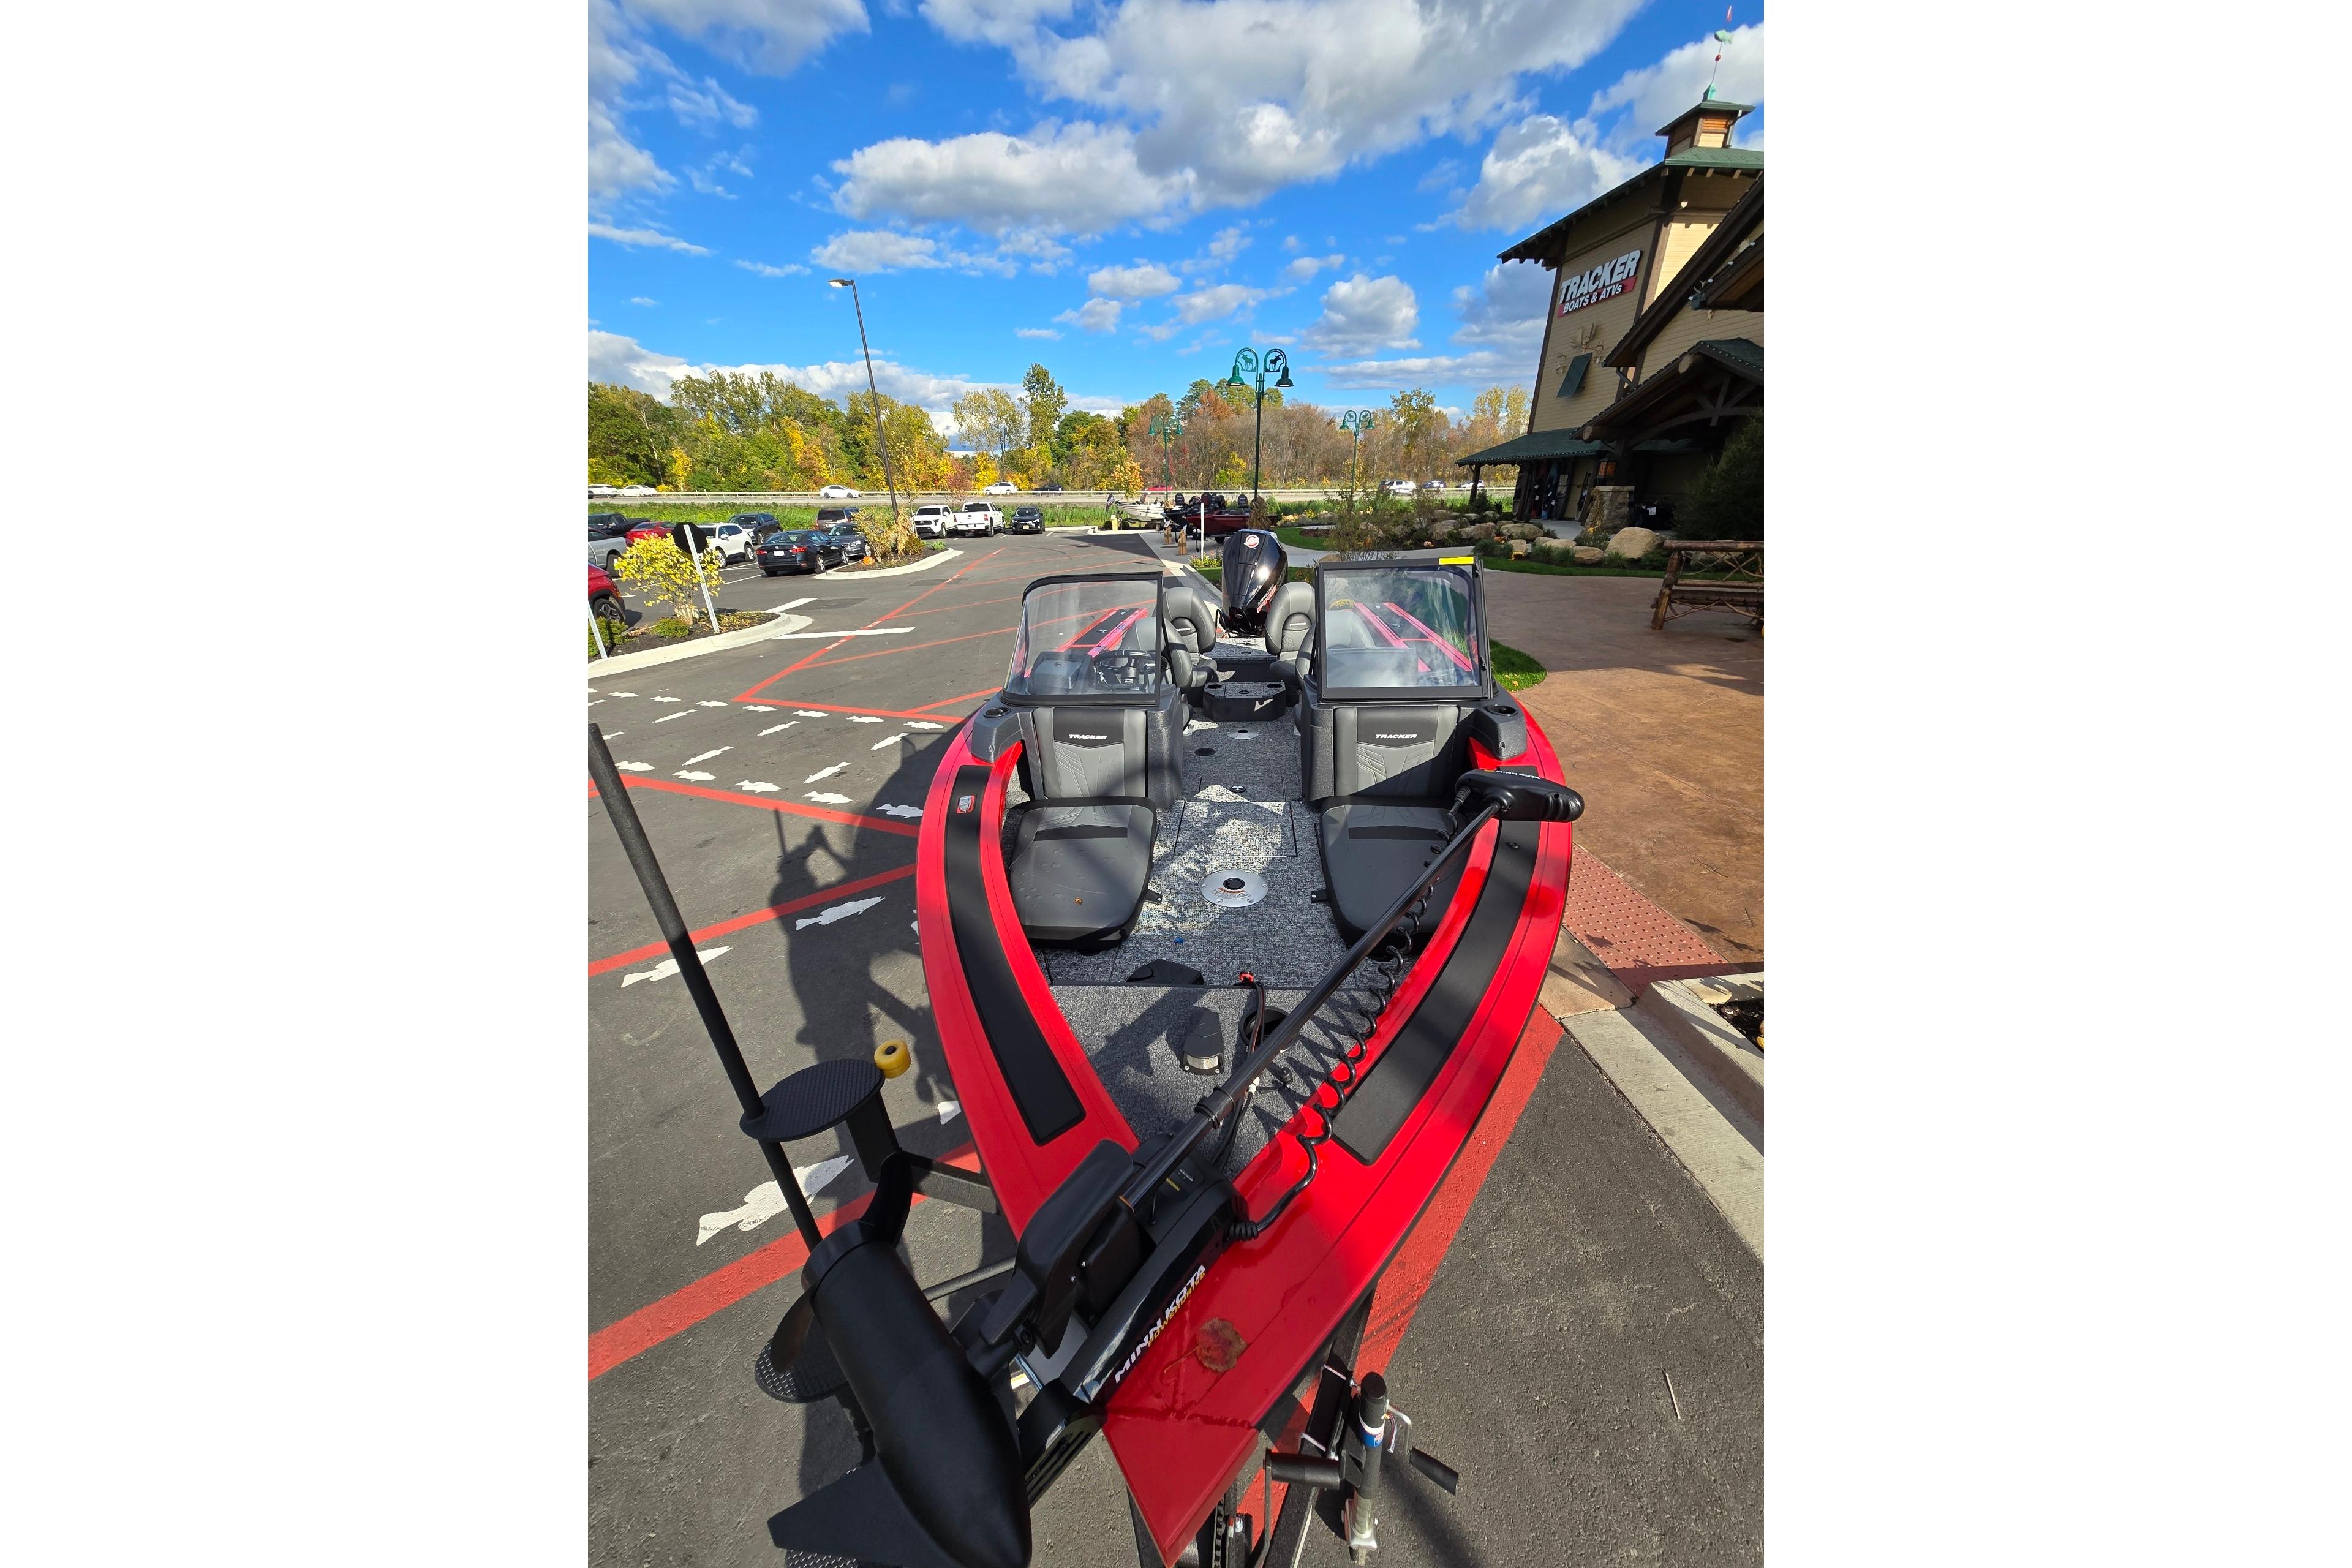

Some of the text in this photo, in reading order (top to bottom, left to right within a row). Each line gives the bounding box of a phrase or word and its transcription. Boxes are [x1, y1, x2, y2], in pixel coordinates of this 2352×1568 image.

[1559, 250, 1641, 304] TRACKER
[1563, 295, 1589, 314] BOATS
[1591, 292, 1597, 304] &
[1115, 1264, 1205, 1384] MINN KOTA
